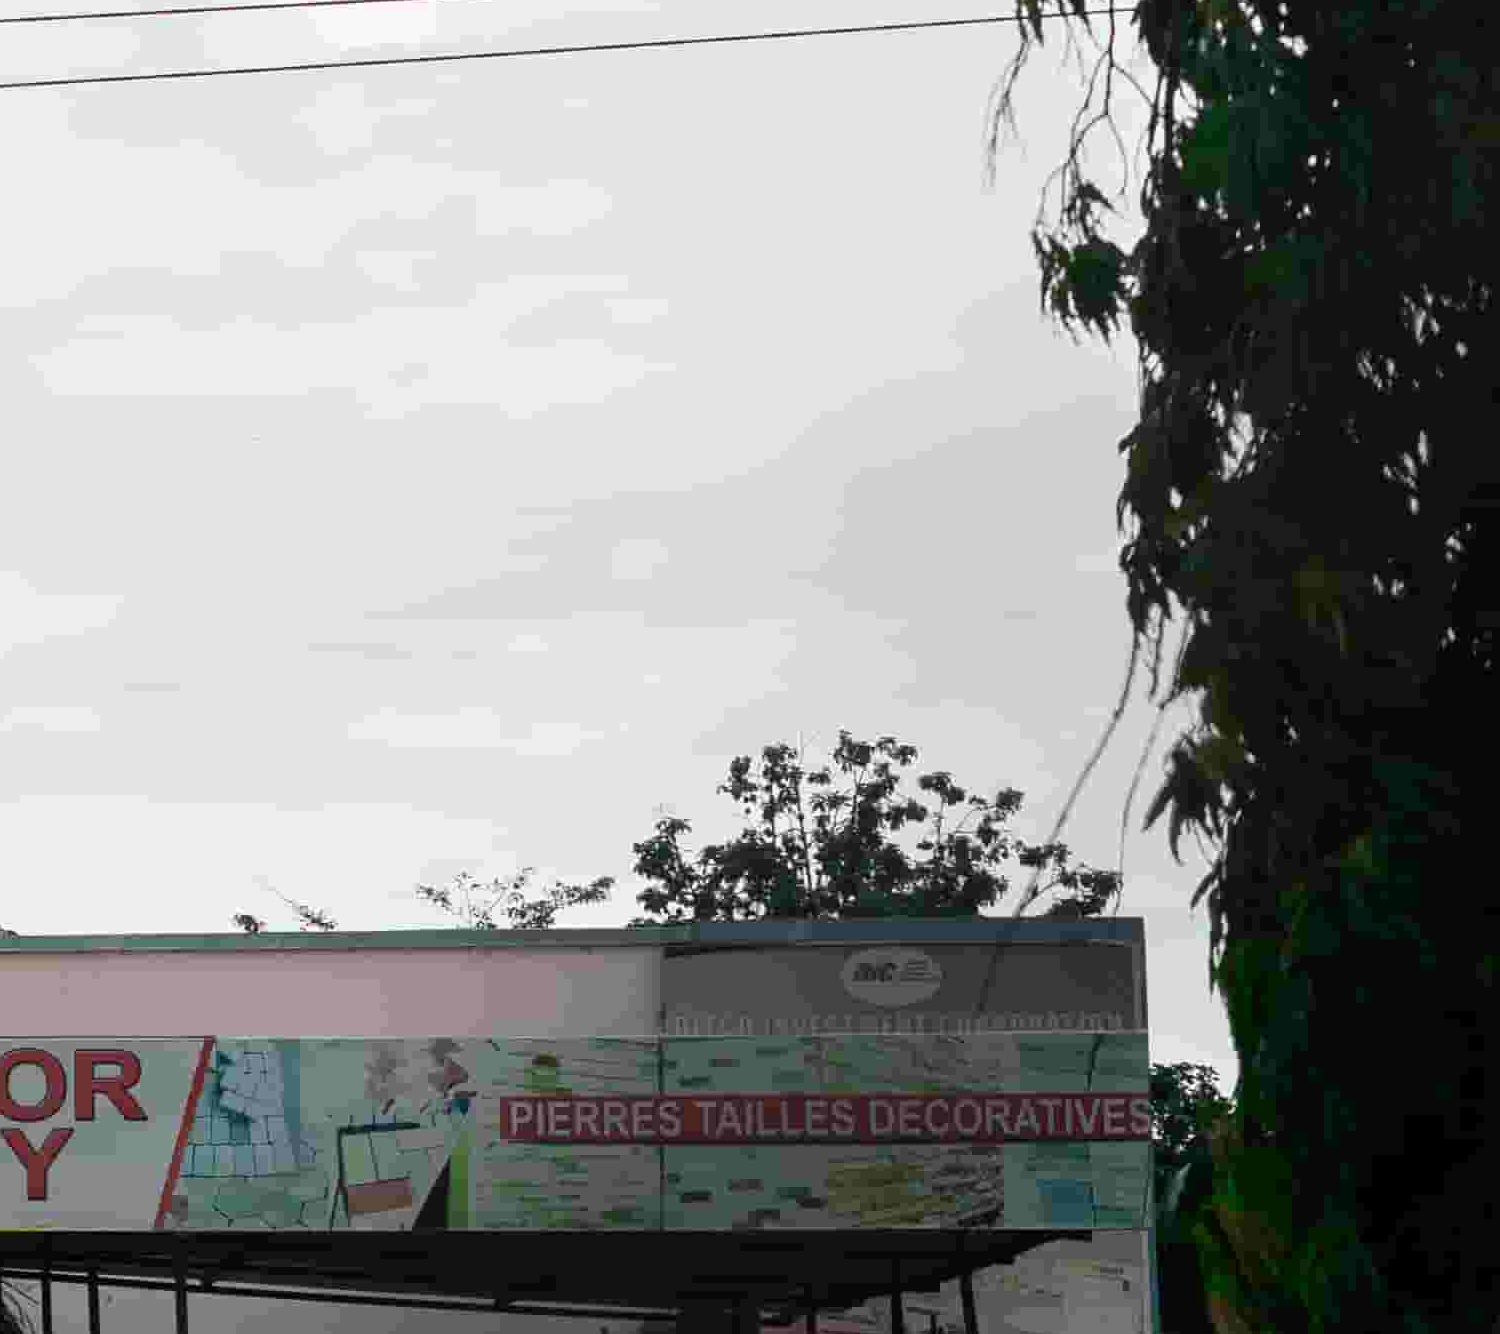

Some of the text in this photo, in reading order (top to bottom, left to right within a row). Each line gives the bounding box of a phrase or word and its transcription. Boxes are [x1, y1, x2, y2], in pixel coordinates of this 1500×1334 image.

[509, 1096, 1154, 1141] PIERRES TAILLES DECORATIVES
